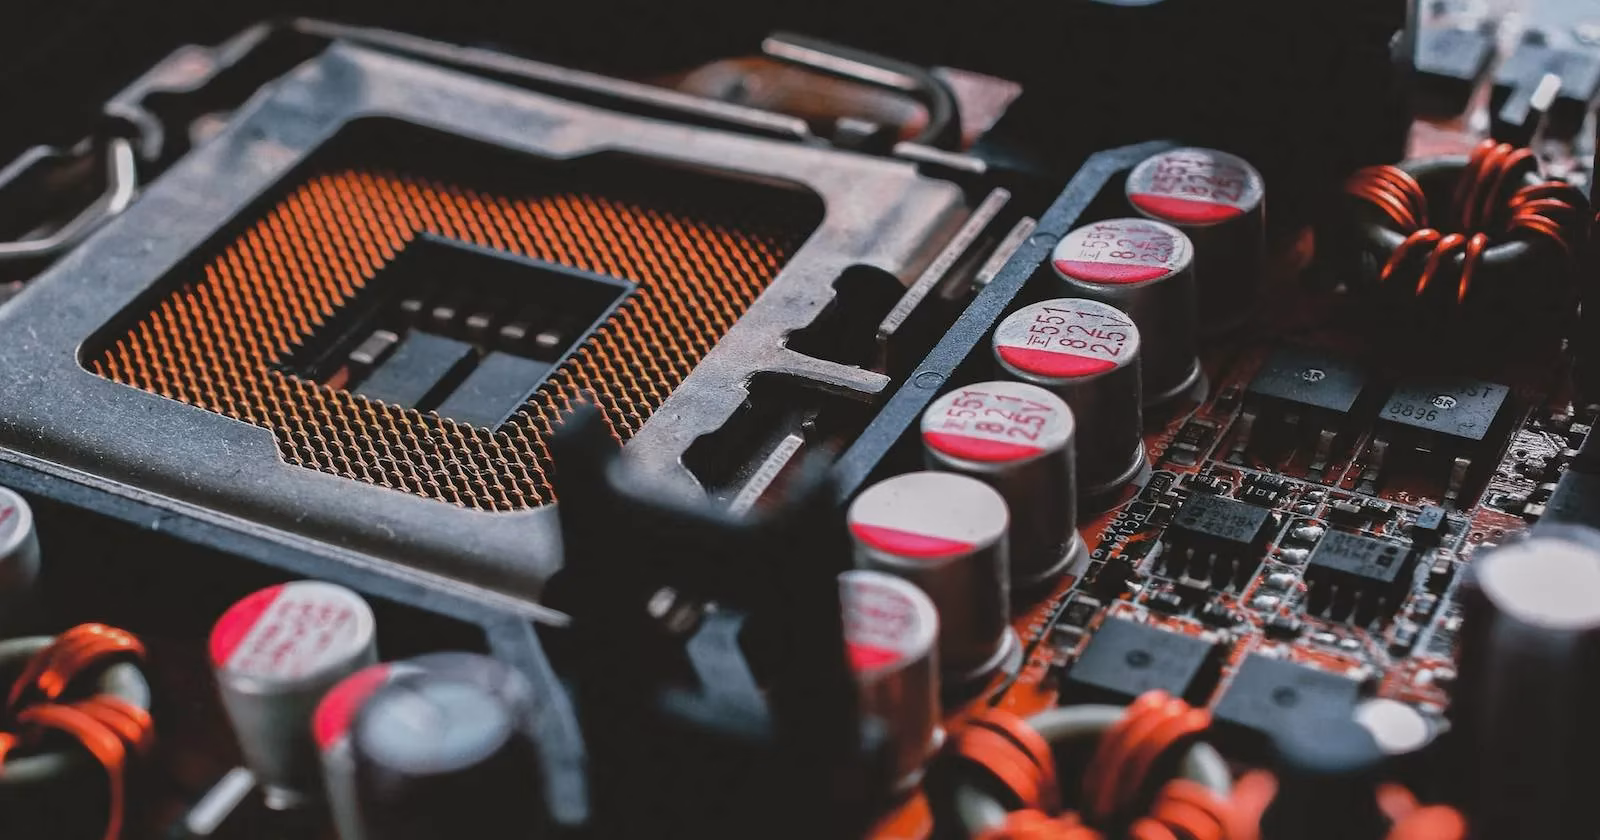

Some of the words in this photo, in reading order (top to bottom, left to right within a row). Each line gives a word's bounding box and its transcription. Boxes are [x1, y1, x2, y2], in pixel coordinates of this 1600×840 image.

[1090, 315, 1133, 356] 2.5V
[1389, 401, 1439, 422] 8896
[1096, 511, 1129, 541] PR42
